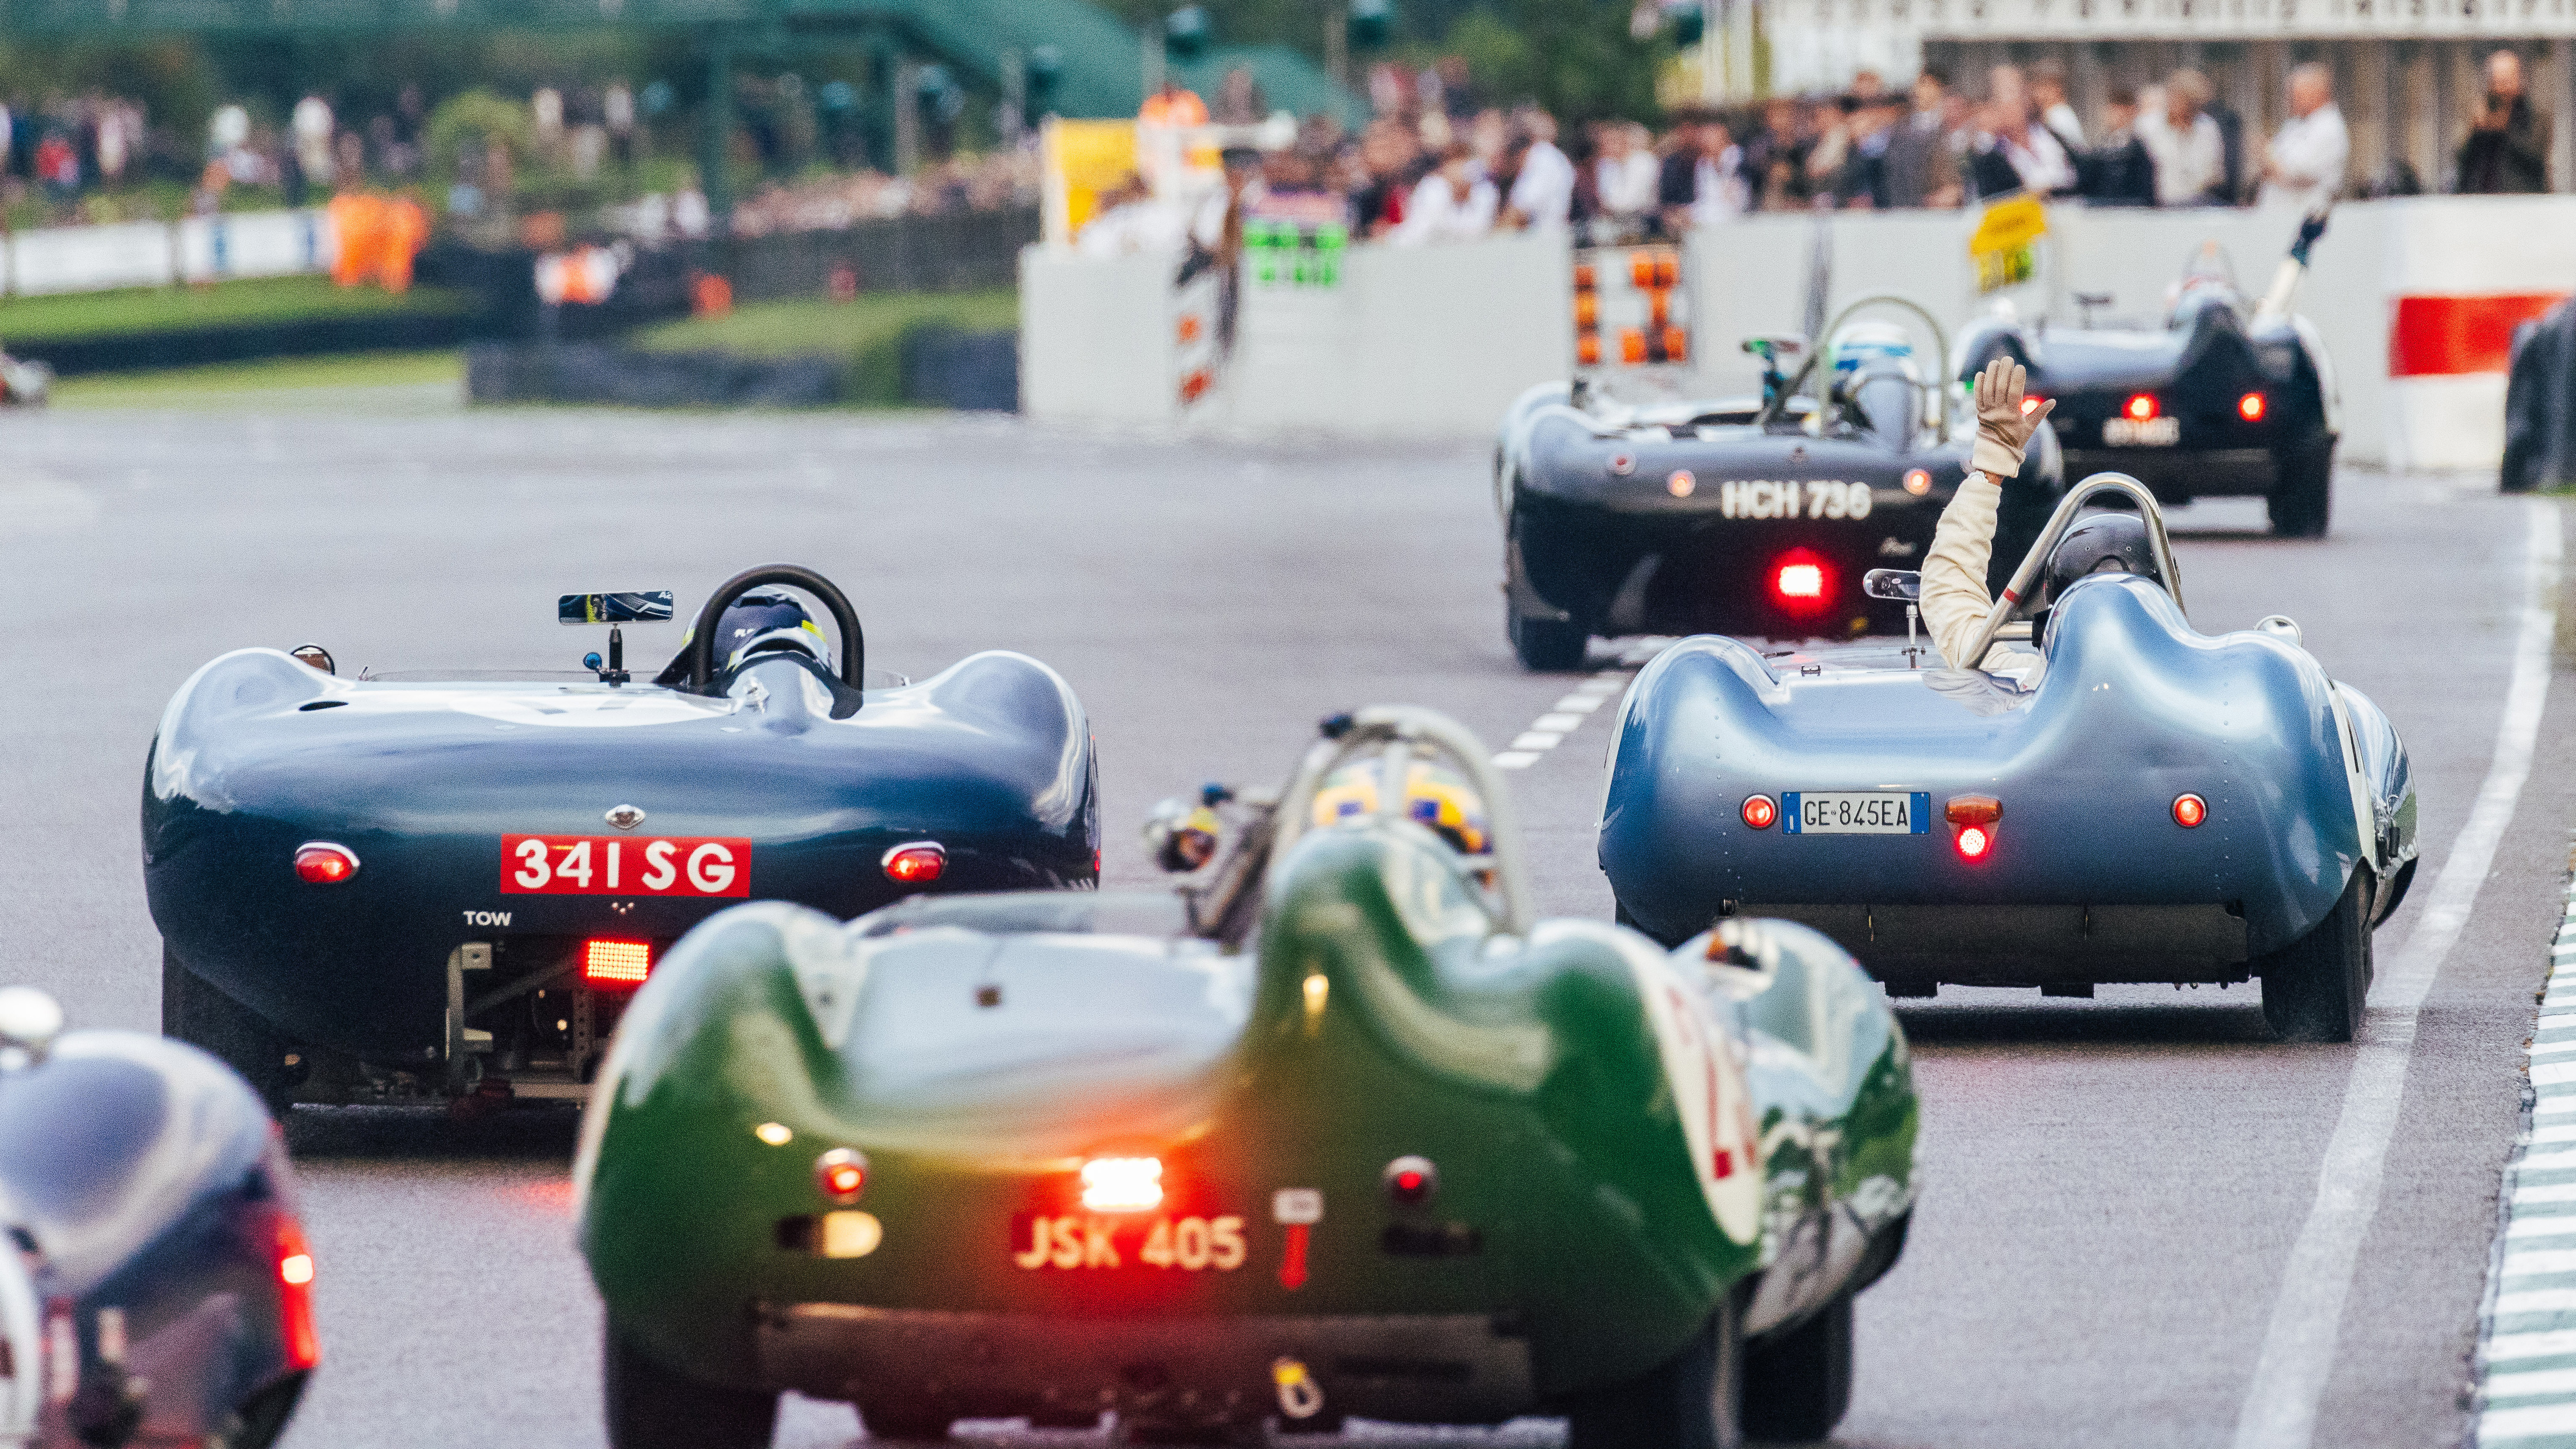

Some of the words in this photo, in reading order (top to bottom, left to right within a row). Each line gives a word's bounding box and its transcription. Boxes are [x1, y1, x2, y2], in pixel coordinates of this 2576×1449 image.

[1722, 480, 1799, 519] HCH
[1807, 480, 1872, 520] 736
[514, 838, 621, 889] 341
[641, 839, 736, 893] SG
[462, 910, 512, 926] TOW
[1016, 1215, 1121, 1271] JSK
[1140, 1215, 1247, 1271] 405
